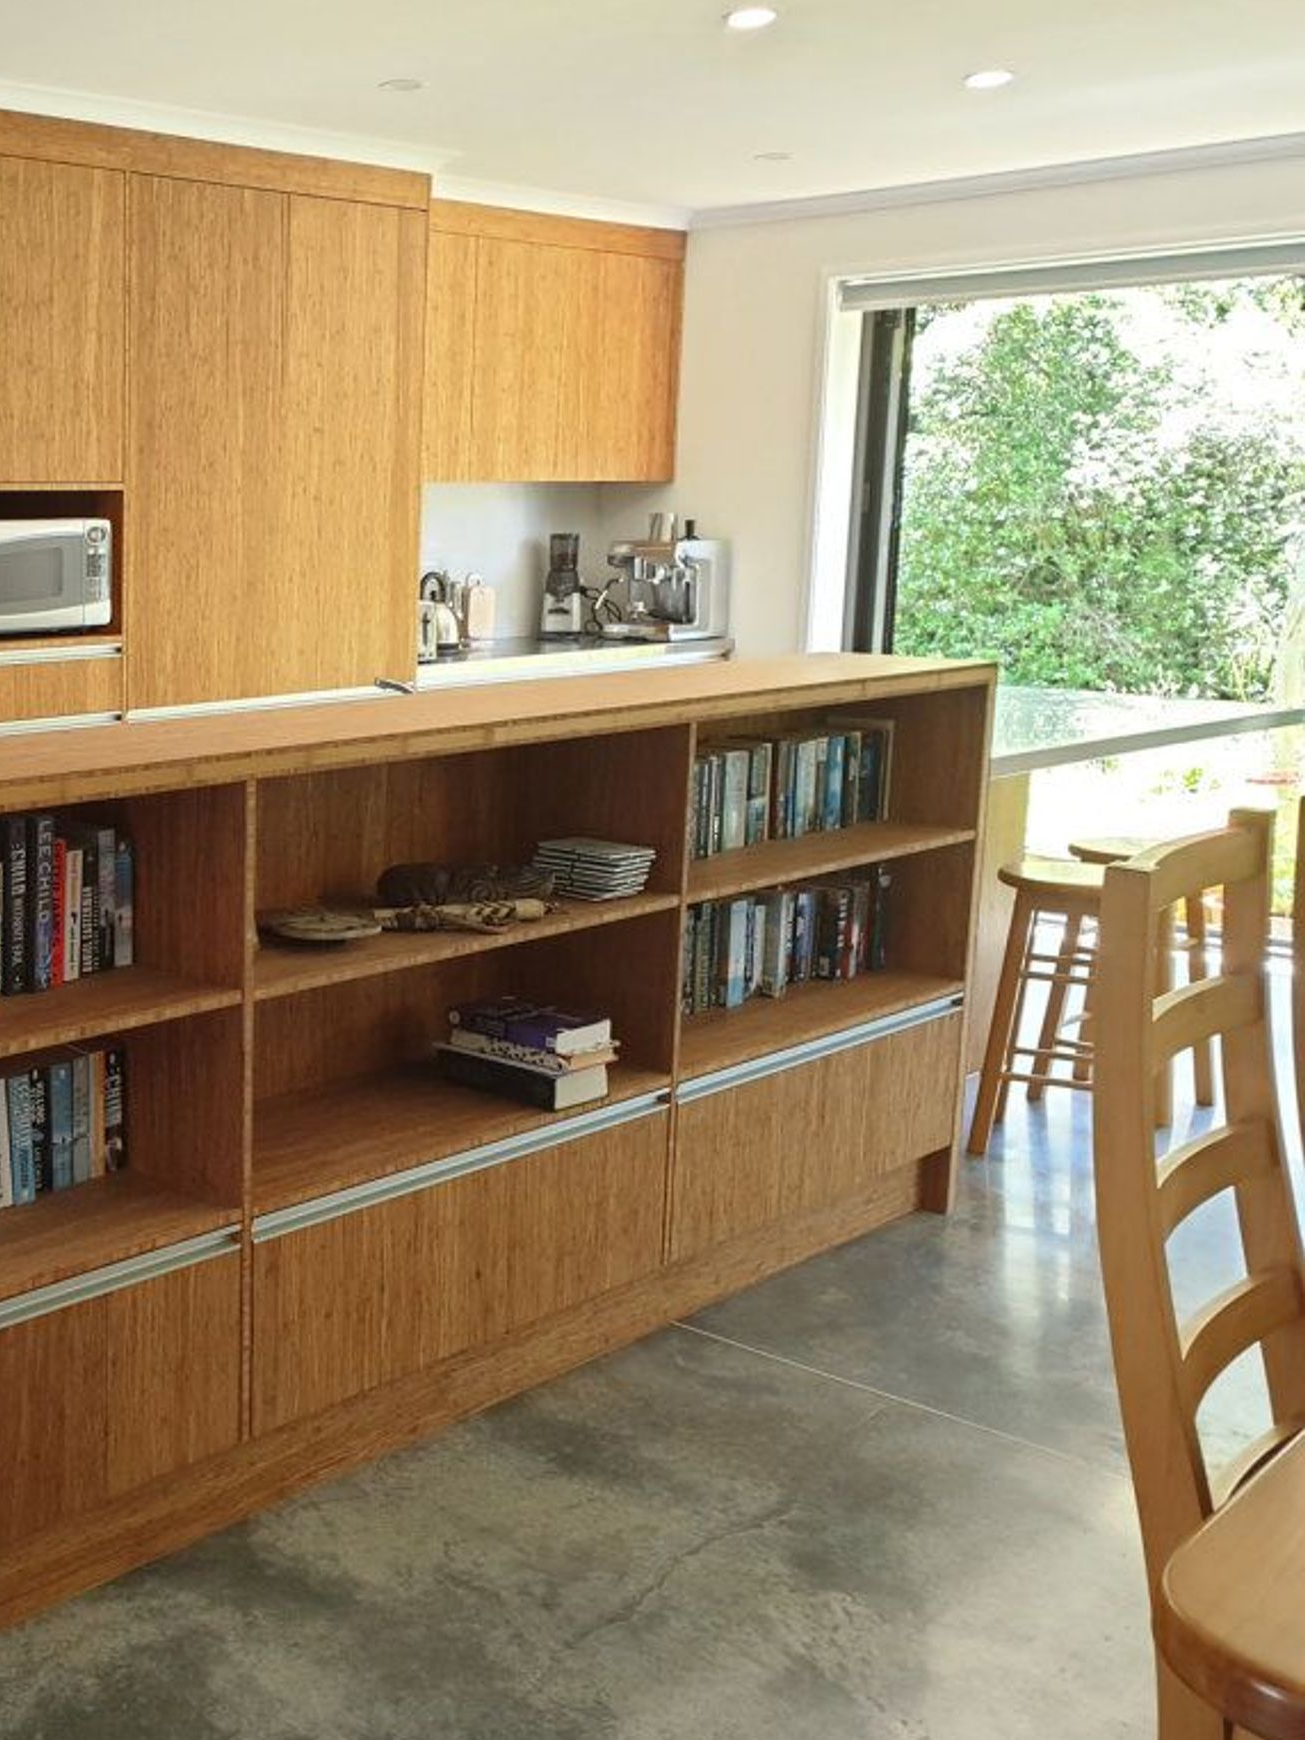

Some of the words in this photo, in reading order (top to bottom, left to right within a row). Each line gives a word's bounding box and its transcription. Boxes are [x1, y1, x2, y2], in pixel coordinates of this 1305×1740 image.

[38, 820, 52, 861] LEE
[11, 849, 26, 897] CHILD
[37, 861, 51, 923] CHILD
